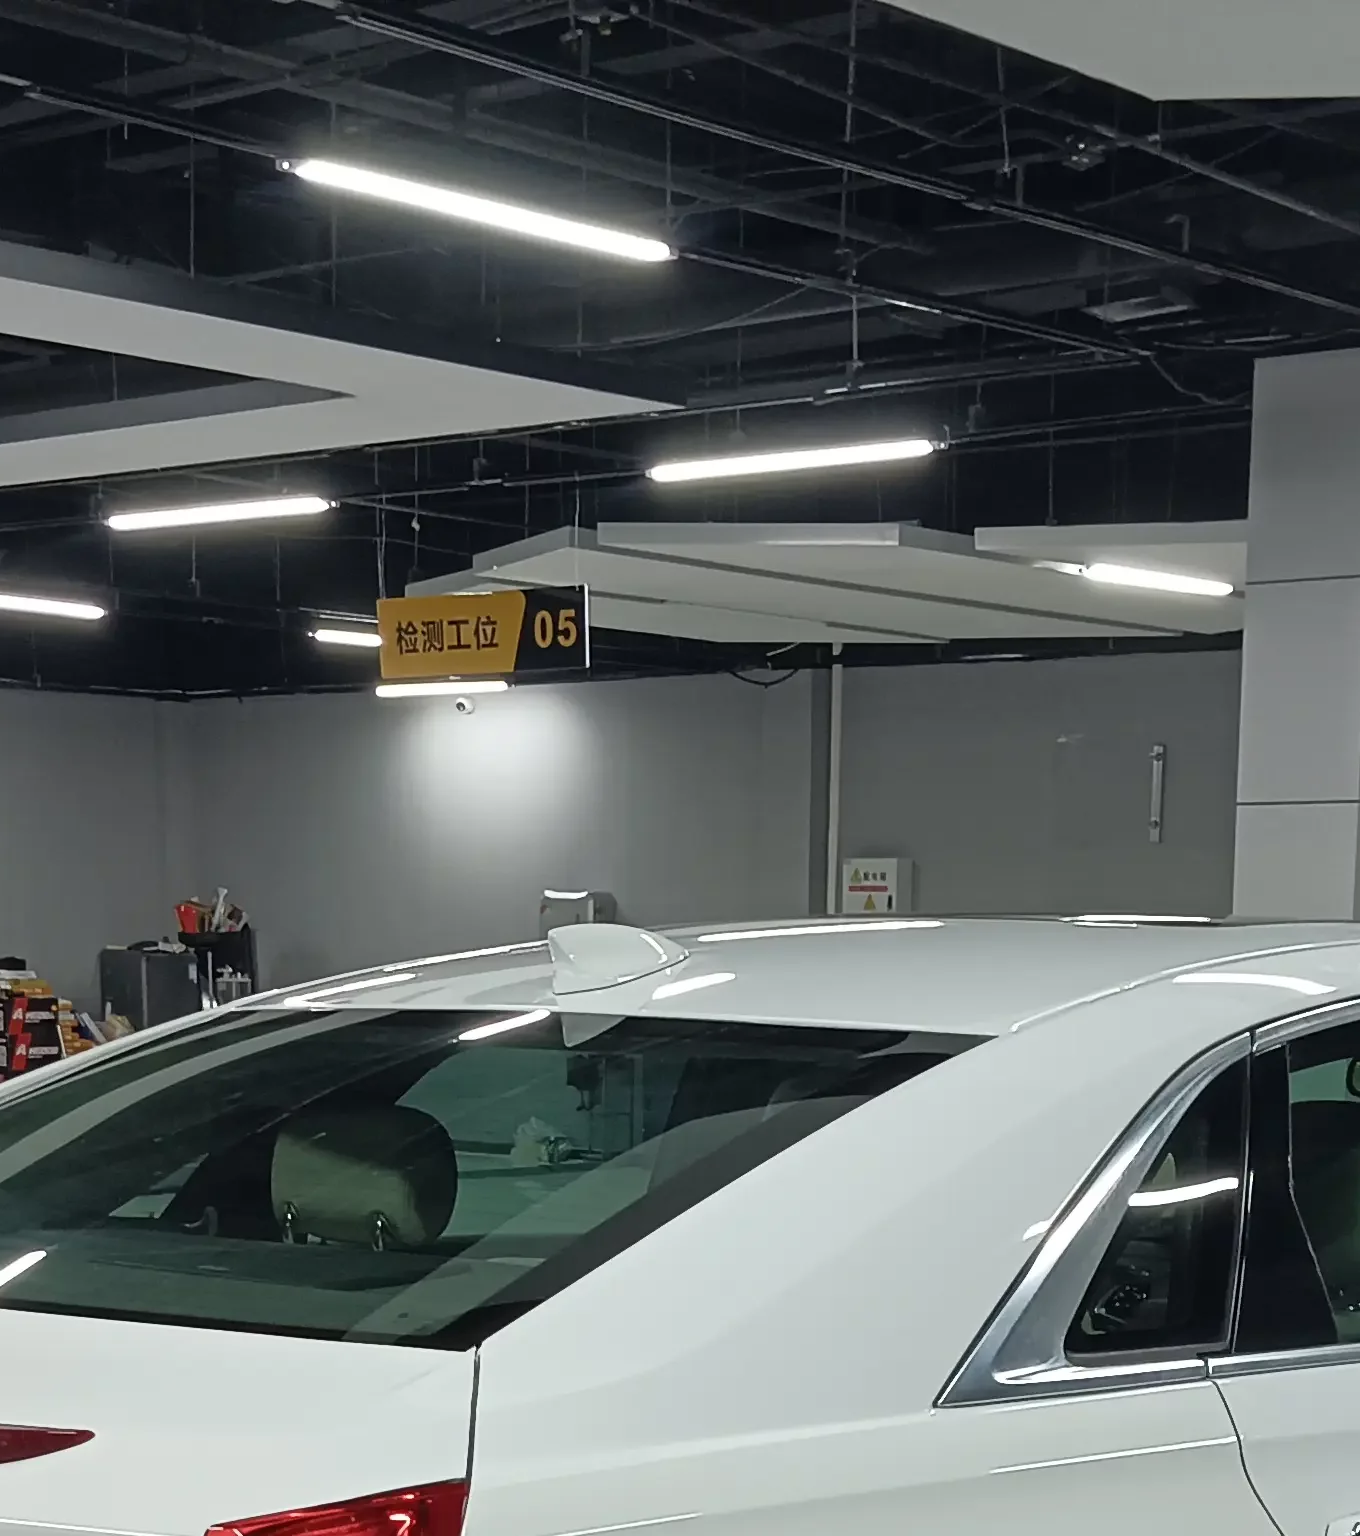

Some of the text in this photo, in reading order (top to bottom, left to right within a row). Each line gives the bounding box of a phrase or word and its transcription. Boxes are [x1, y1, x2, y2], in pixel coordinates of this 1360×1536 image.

[396, 608, 578, 656] 检测工位 05
